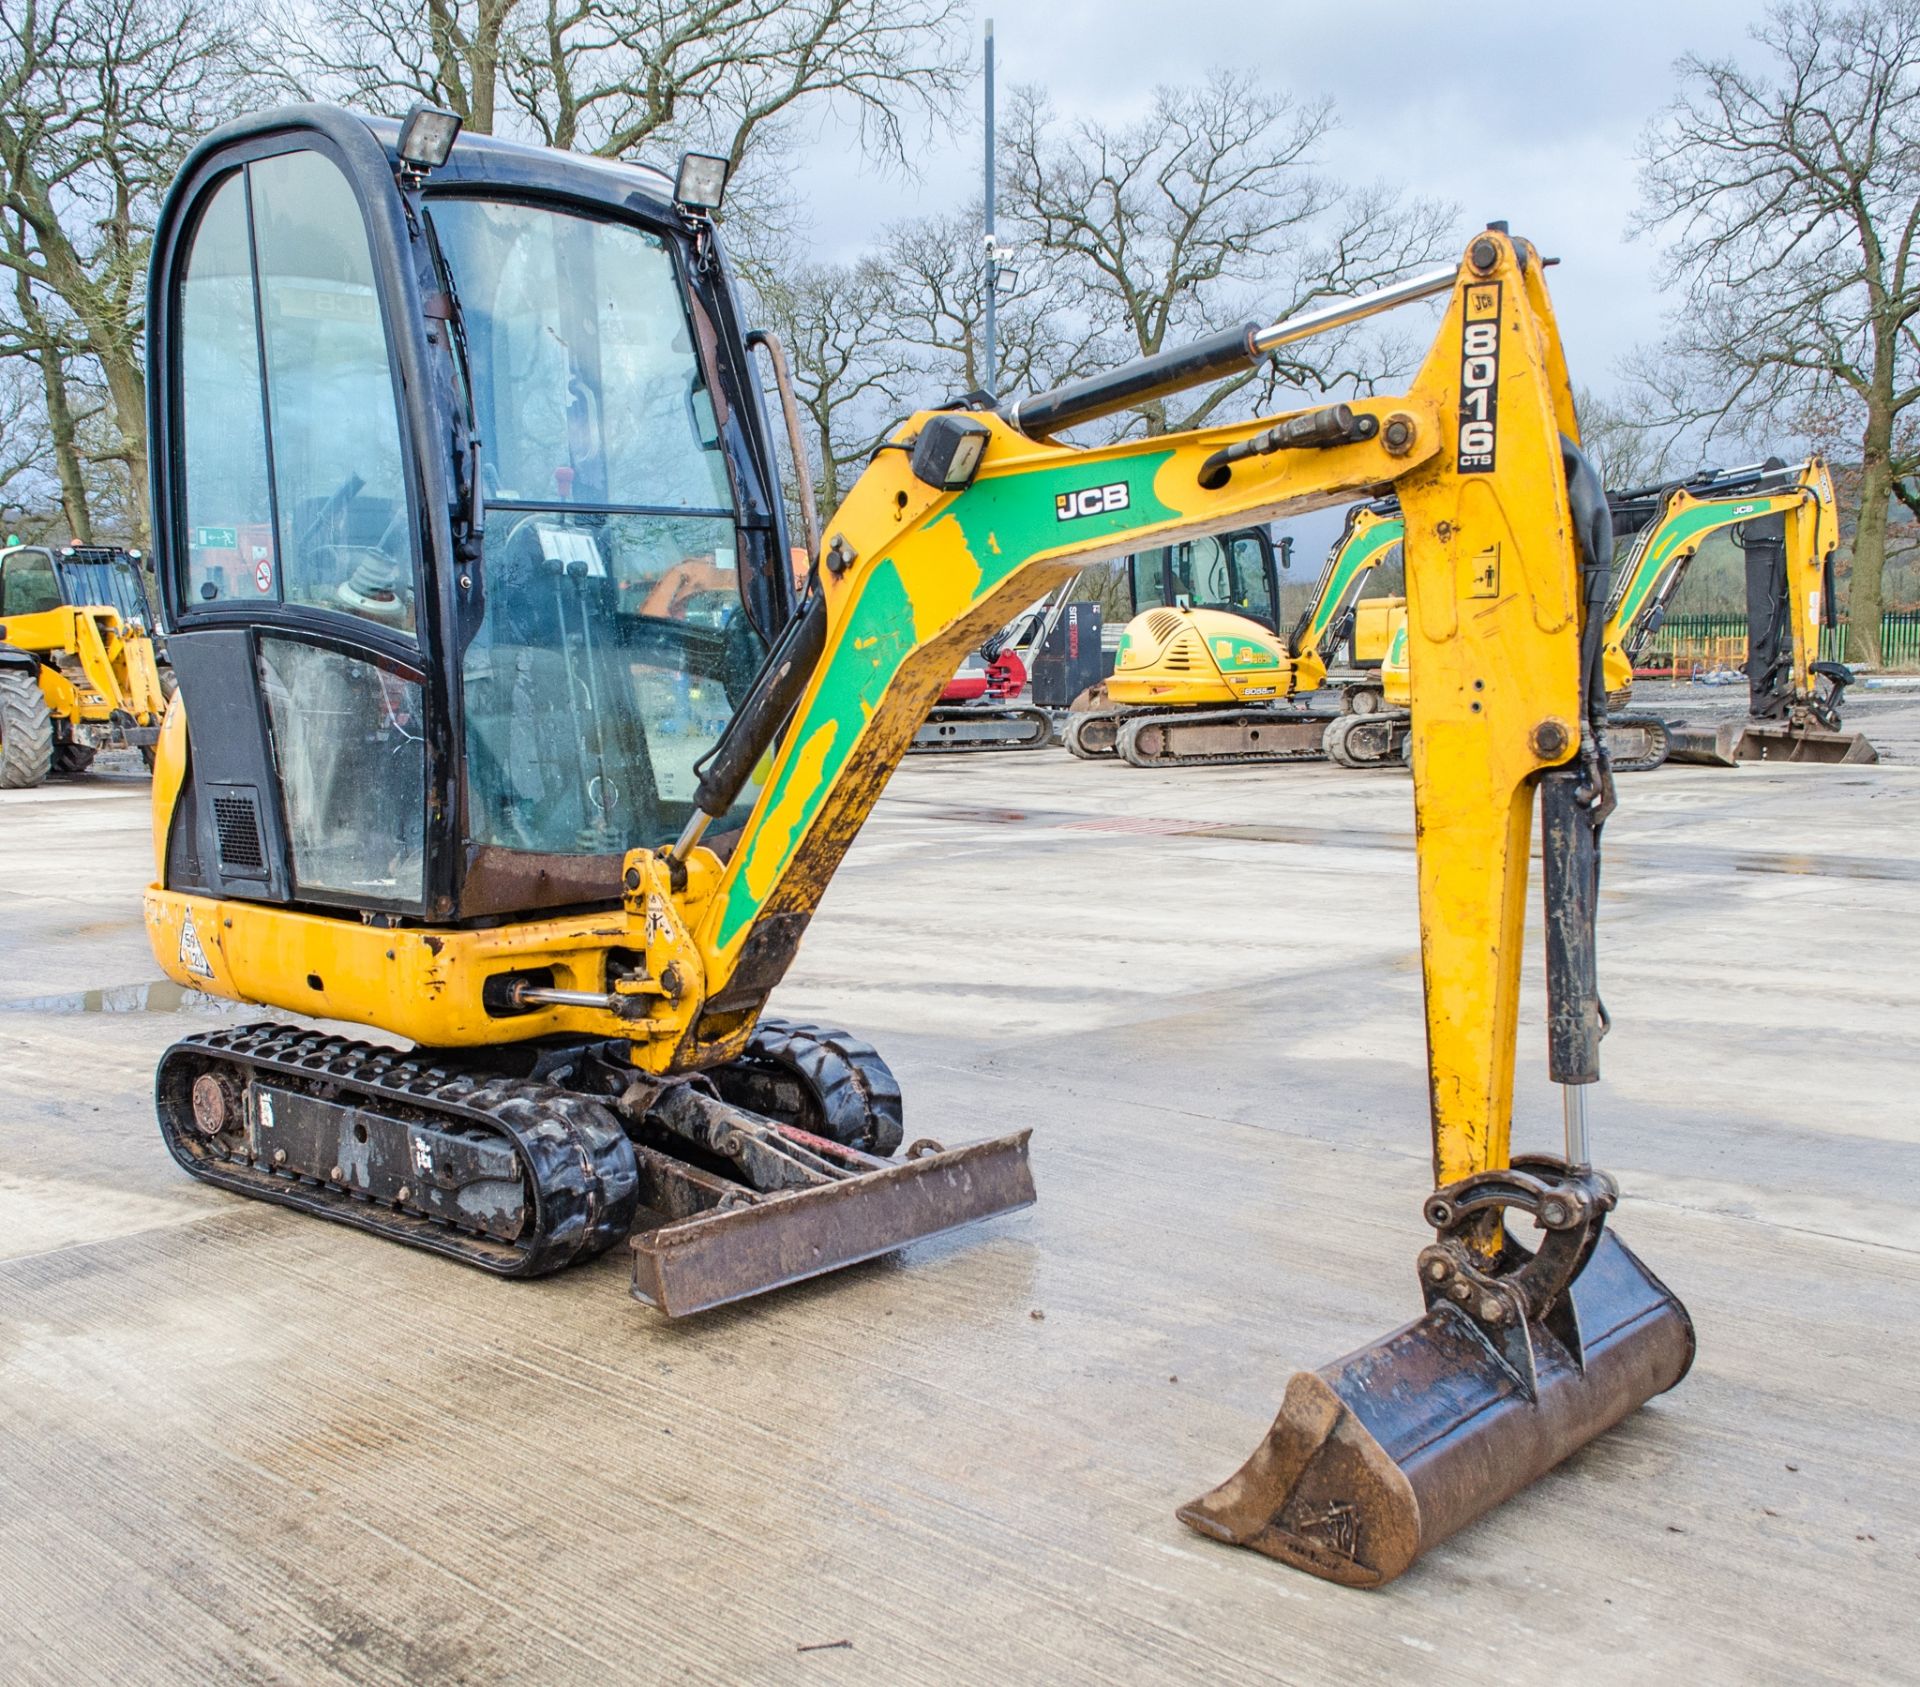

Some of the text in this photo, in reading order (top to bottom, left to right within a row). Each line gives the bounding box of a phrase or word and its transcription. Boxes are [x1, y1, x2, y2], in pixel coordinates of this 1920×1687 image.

[1475, 295, 1493, 311] JCB
[1459, 323, 1498, 455] 8016
[1460, 455, 1492, 466] CTS
[1057, 483, 1129, 520] JCB
[1733, 505, 1754, 514] JCB
